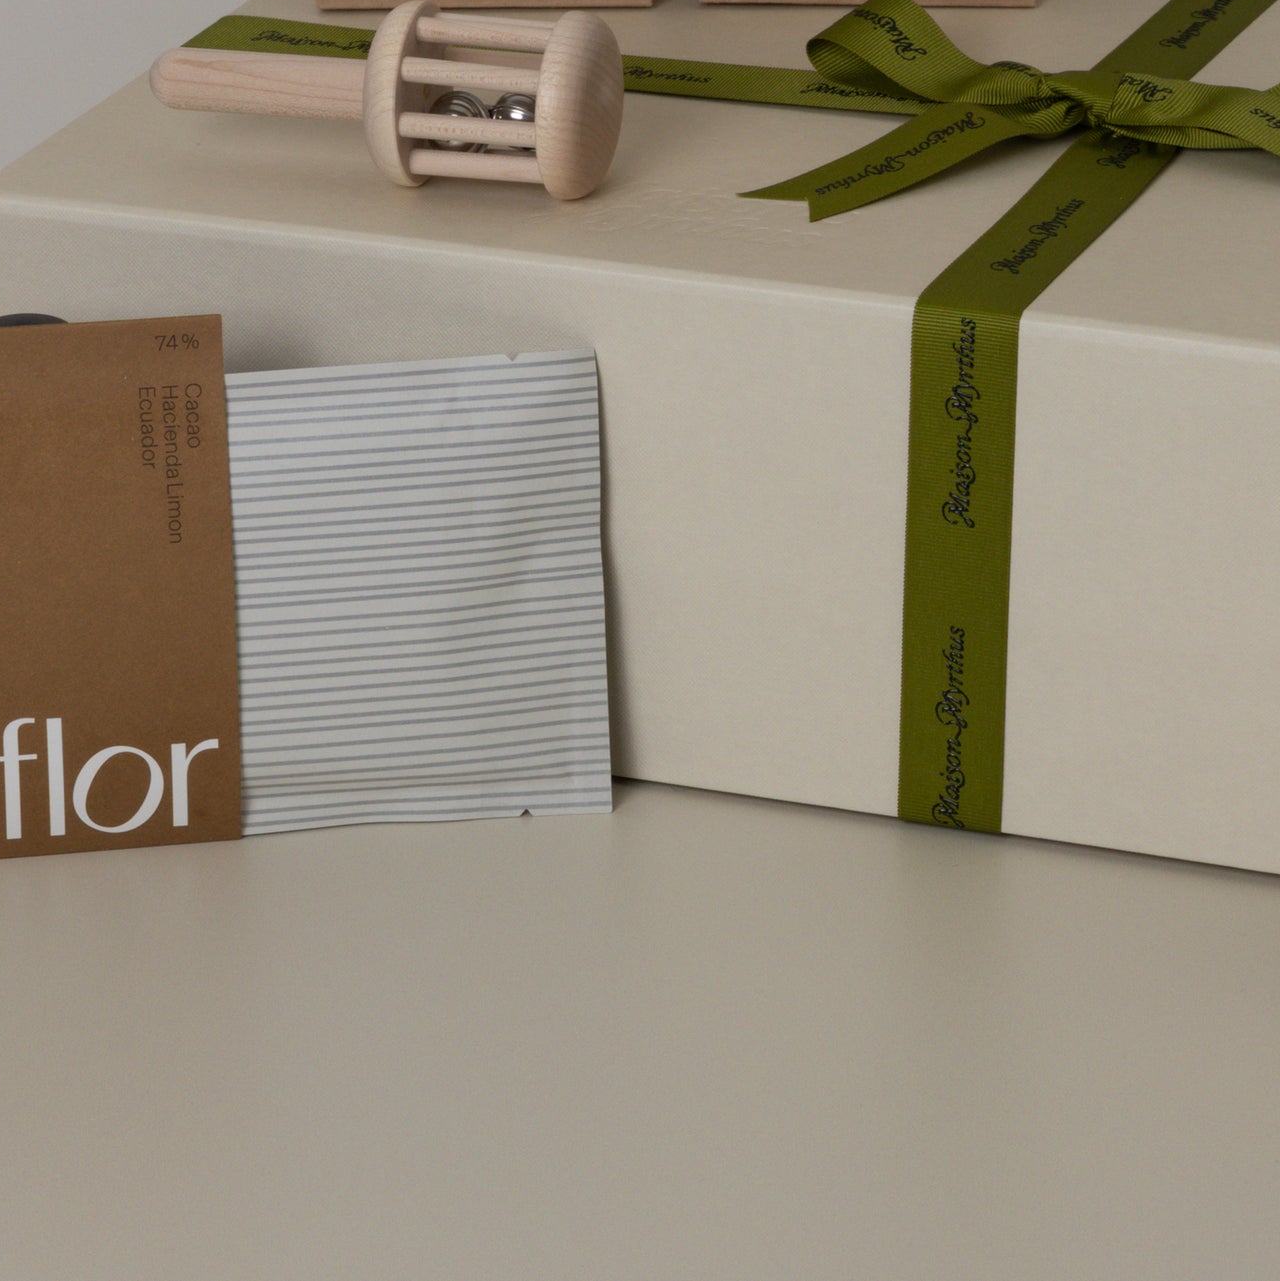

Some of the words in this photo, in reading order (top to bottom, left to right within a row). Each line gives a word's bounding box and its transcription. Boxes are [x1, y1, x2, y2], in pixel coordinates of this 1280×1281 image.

[1159, 20, 1206, 50] Maison
[902, 111, 986, 157] Maison
[814, 155, 905, 196] Myrthus
[990, 238, 1046, 275] Maison
[1029, 199, 1085, 237] Myrthus
[154, 334, 179, 351] 74
[944, 316, 980, 424] Myrthus
[138, 386, 159, 469] Ecuador
[162, 385, 183, 478] Hacienda
[184, 383, 203, 448] Cacao
[166, 483, 185, 544] Limon
[941, 423, 976, 528] Maison
[934, 625, 970, 729] Myrthus
[932, 727, 966, 828] Maison
